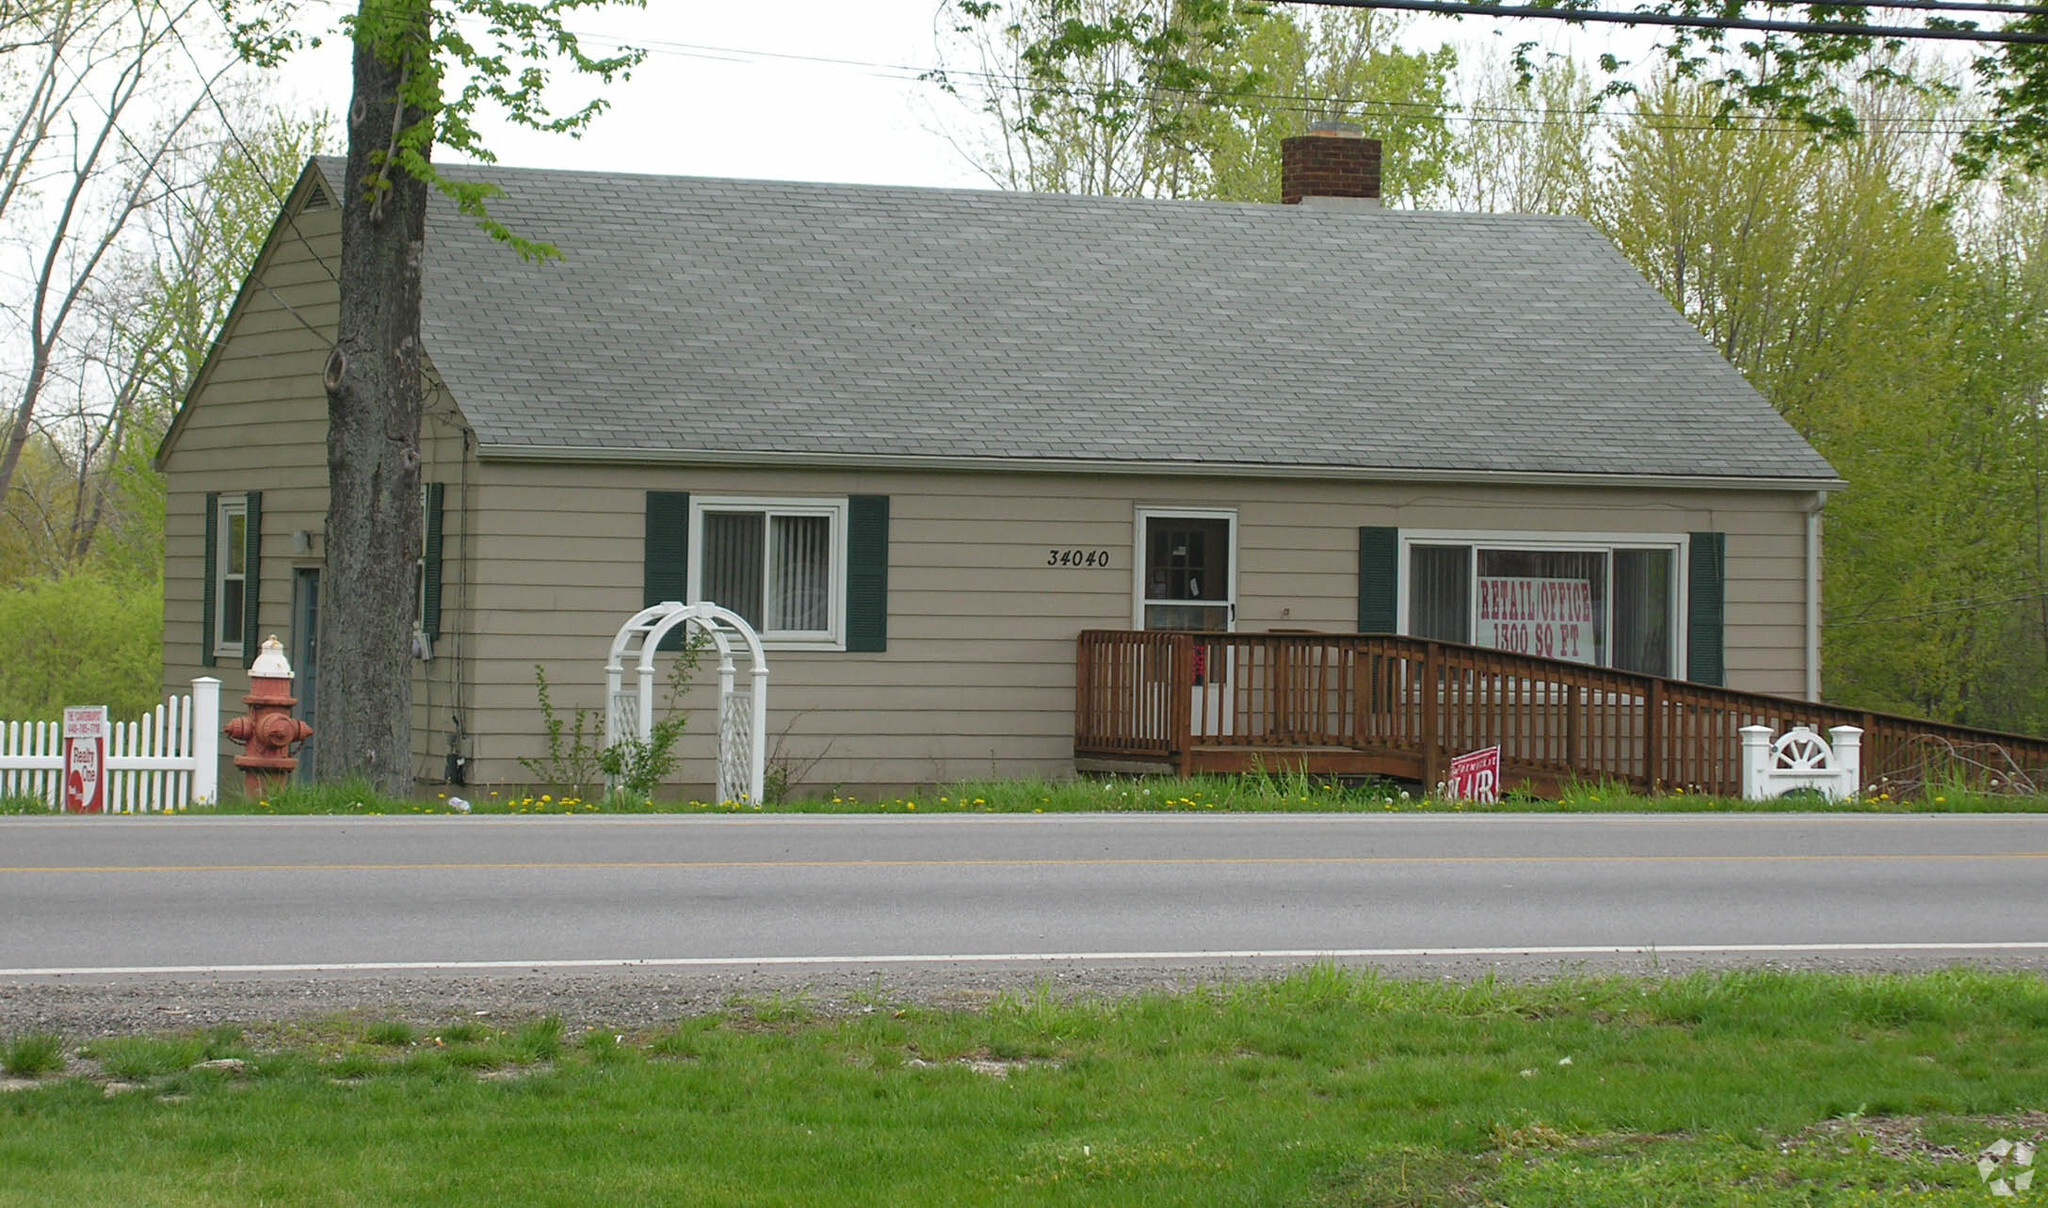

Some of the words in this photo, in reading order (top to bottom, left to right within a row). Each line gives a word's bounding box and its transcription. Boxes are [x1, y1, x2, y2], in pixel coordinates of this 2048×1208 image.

[1047, 550, 1109, 567] 34040
[1494, 623, 1528, 655] 1300
[1535, 623, 1554, 657] SQ
[1560, 624, 1579, 657] FT
[73, 747, 95, 767] Realty
[82, 765, 95, 782] One
